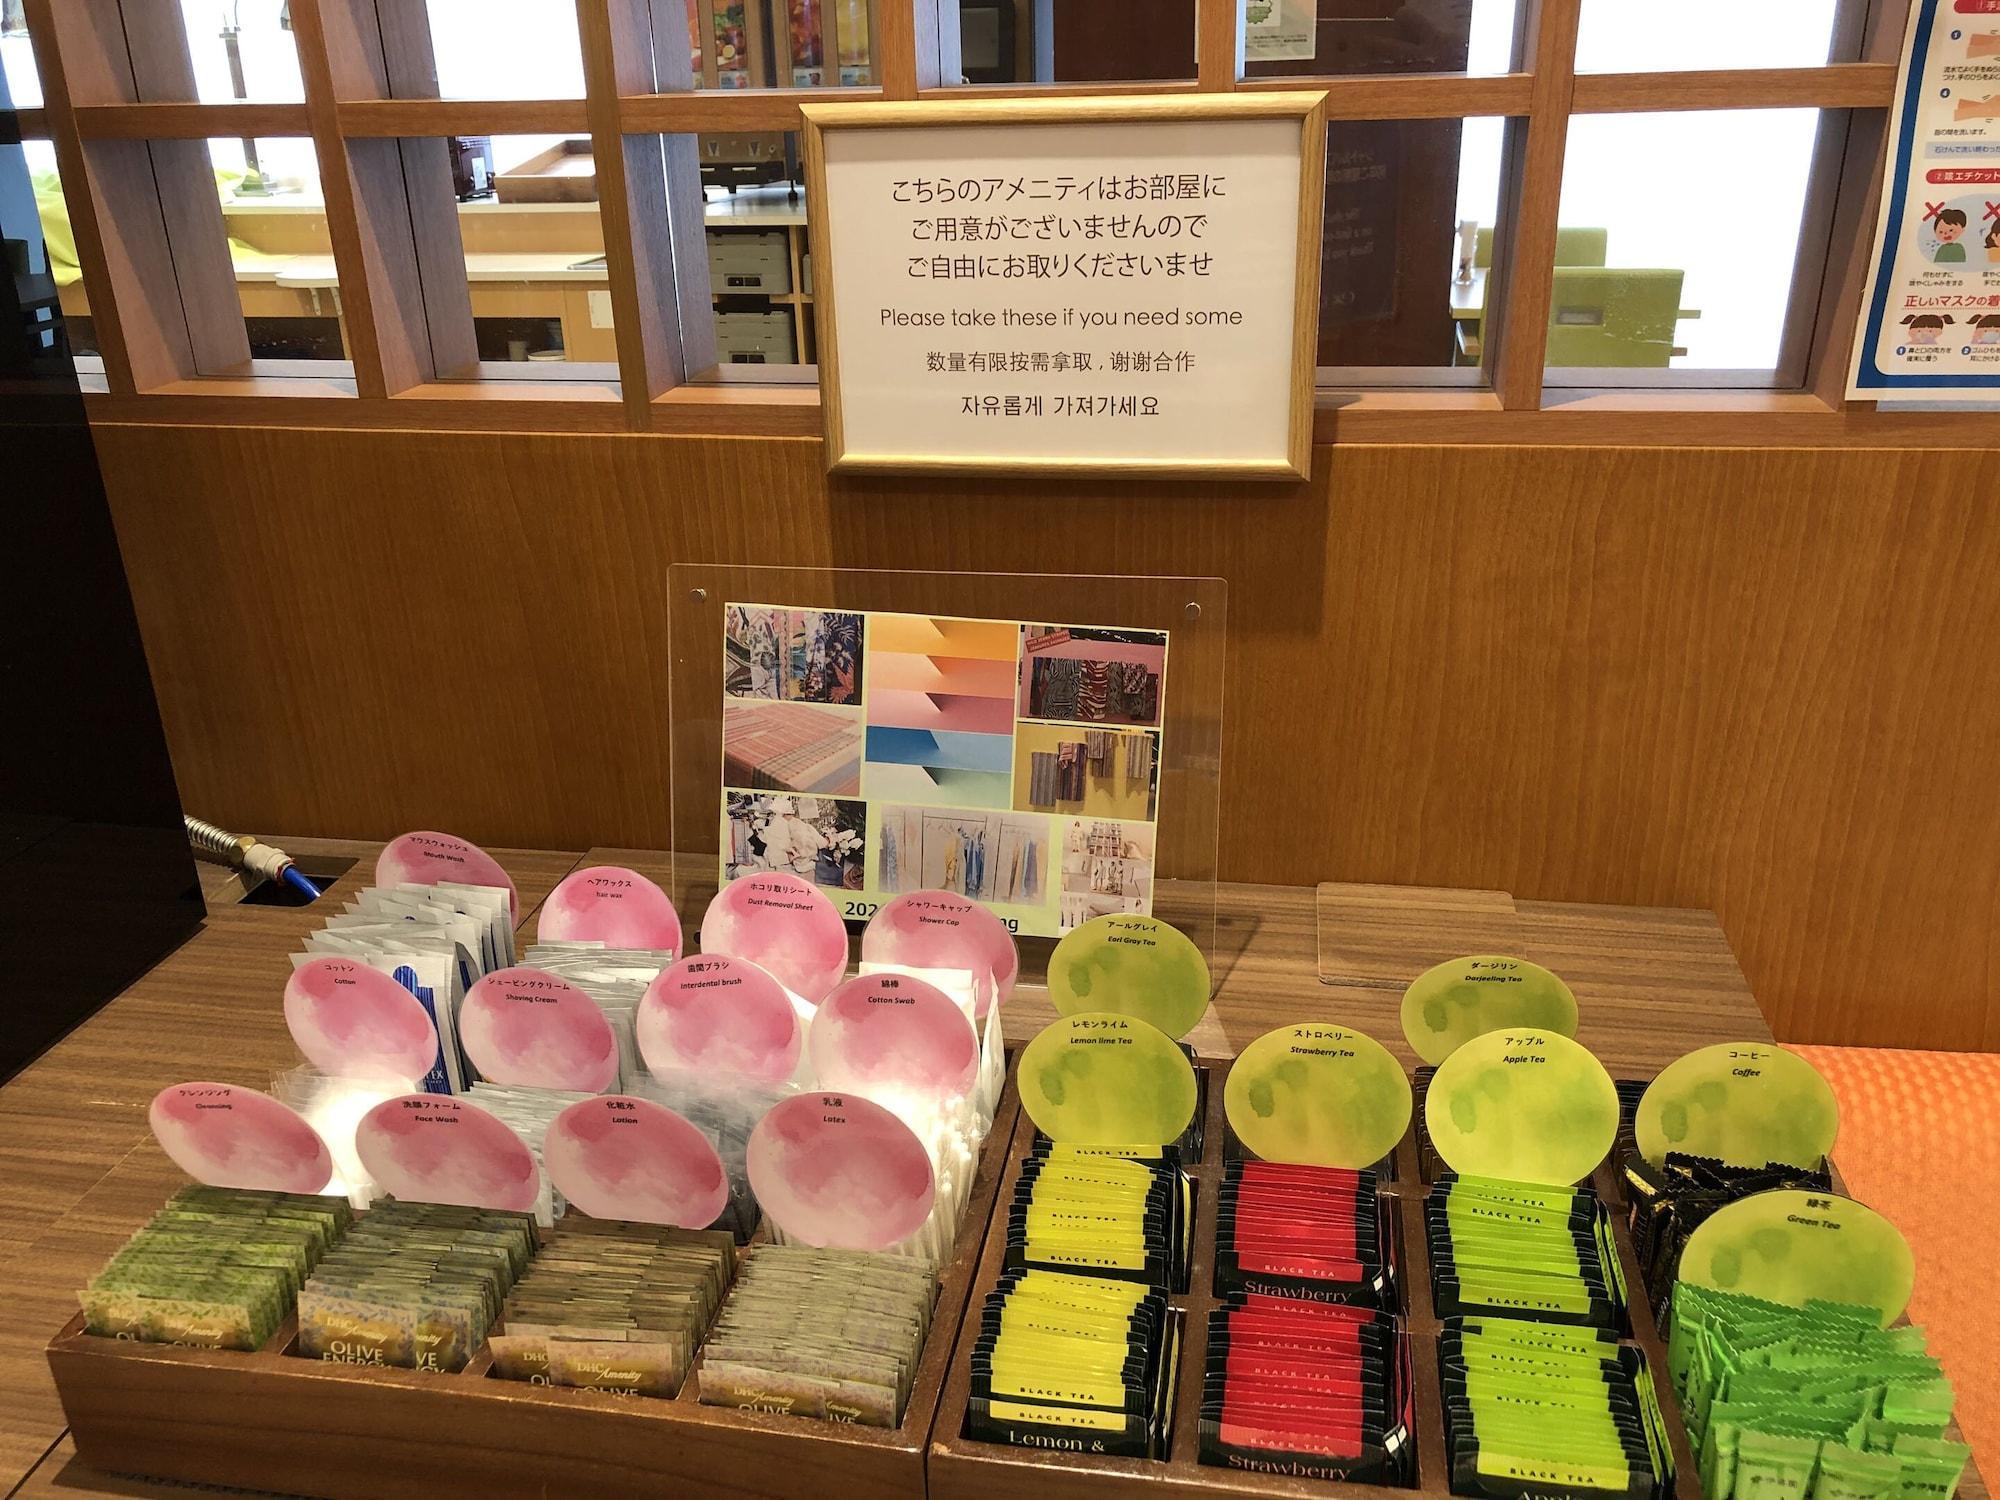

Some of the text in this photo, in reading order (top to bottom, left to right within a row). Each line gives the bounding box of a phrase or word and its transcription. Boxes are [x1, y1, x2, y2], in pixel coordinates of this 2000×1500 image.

[891, 173, 1226, 203] こちらのアメニティはお部屋に
[911, 213, 1208, 242] ご用意がございませんので
[907, 252, 1212, 280] ご自由にお取りくださいませ
[881, 307, 1243, 330] Please take these if you need some
[961, 394, 1160, 417] 자유롭게 가져가세요
[424, 851, 465, 863] Mouth Wash
[587, 878, 632, 888] ヘアワックス
[750, 882, 813, 897] ホコリ取りシート
[747, 897, 814, 911] Dust Removal Sheet
[907, 900, 973, 913] シャワーキャップ
[919, 916, 961, 927] Shower Cap
[1107, 921, 1158, 933] アールグレイ
[324, 963, 354, 973] コットン
[687, 961, 730, 974] 歯間ブラシ
[1471, 961, 1518, 971] ダージリン
[334, 977, 356, 986] Cotton
[487, 977, 571, 991] シェービングクリーム
[680, 976, 742, 990] Interdental brush
[880, 979, 899, 988] 綿棒
[1464, 975, 1505, 984] Darjeeling
[505, 992, 558, 1005] Shaving Cream
[867, 995, 916, 1006] Cotton Swab
[1072, 1020, 1128, 1029] レモンライム
[1294, 1029, 1354, 1040] ストロベリー
[1505, 1036, 1545, 1047] アップル
[1290, 1046, 1354, 1058] Strawberry Tea
[1729, 1051, 1770, 1060] コーヒー
[1502, 1054, 1546, 1065] Apple Tea
[1732, 1067, 1761, 1078] Coffee
[606, 1101, 636, 1111] 化粧水
[823, 1097, 843, 1108] 乳液
[414, 1115, 459, 1125] Face Wash
[612, 1116, 638, 1125] Lotion
[823, 1115, 846, 1124] Latex
[1472, 1208, 1540, 1224] BLACK TEA
[1787, 1214, 1841, 1230] Green Tea
[1050, 1255, 1088, 1263] BLACK
[1264, 1264, 1335, 1278] BLACK TEA
[1244, 1280, 1352, 1305] Strawberry
[1487, 1297, 1561, 1310] BLACK TEA
[327, 1316, 352, 1329] DHC
[330, 1340, 384, 1362] OLIVE
[577, 1361, 643, 1383] DHC Amenity
[1255, 1367, 1297, 1378] BLACK
[1020, 1386, 1095, 1401] BLACK TEA
[1019, 1411, 1095, 1425] BLACK TEA
[1009, 1430, 1105, 1452] Lemon &
[1250, 1438, 1331, 1453] BLACK TEA
[1228, 1454, 1351, 1481] Strawberry
[1510, 1467, 1594, 1484] BLACK TEA
